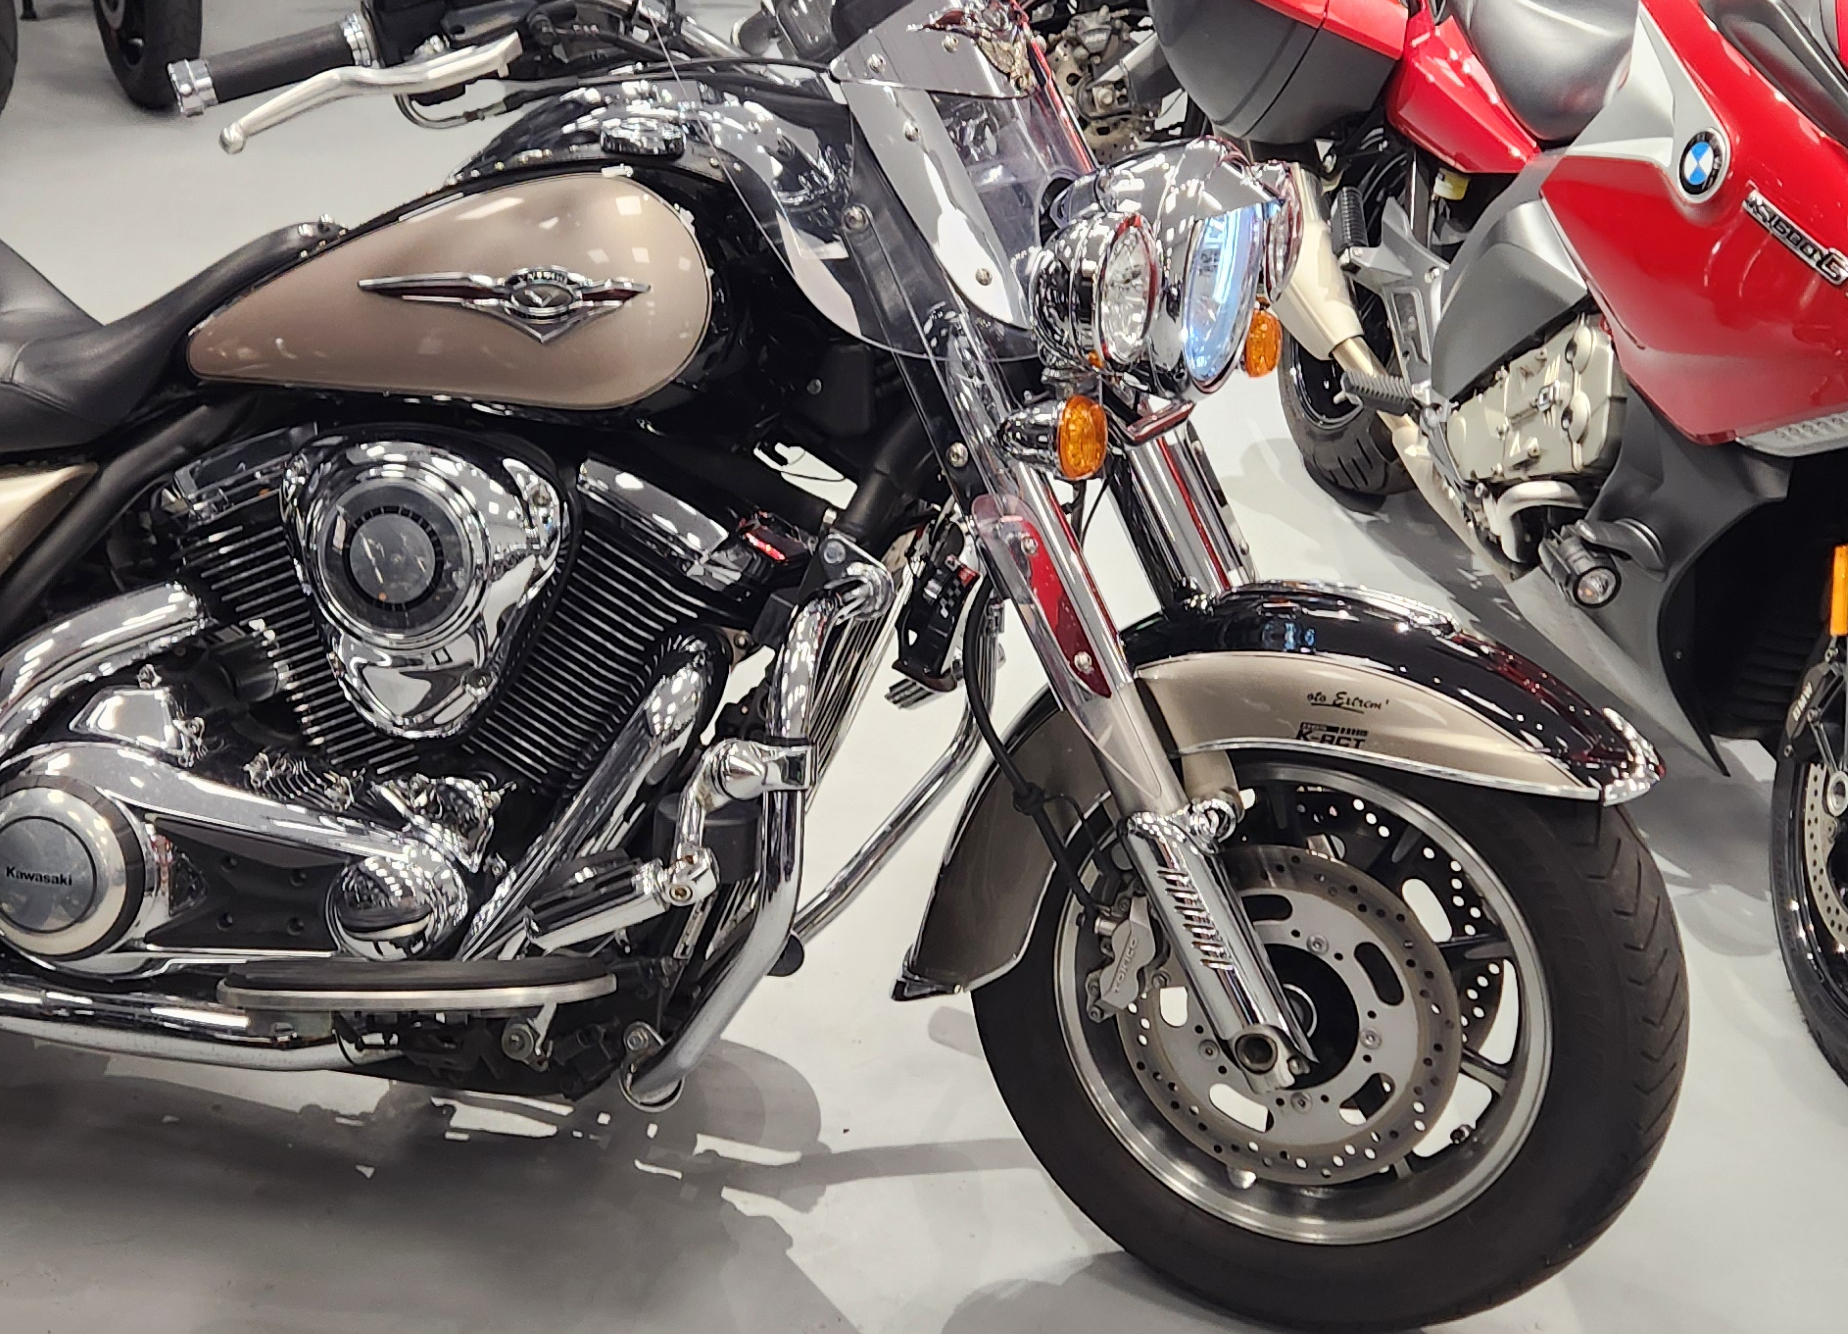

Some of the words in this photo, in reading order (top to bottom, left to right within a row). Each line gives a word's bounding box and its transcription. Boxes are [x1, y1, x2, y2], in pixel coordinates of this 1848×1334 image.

[1295, 729, 1366, 749] K-ACT
[6, 866, 73, 886] Kawasaki
[1112, 938, 1138, 994] TOKICO
